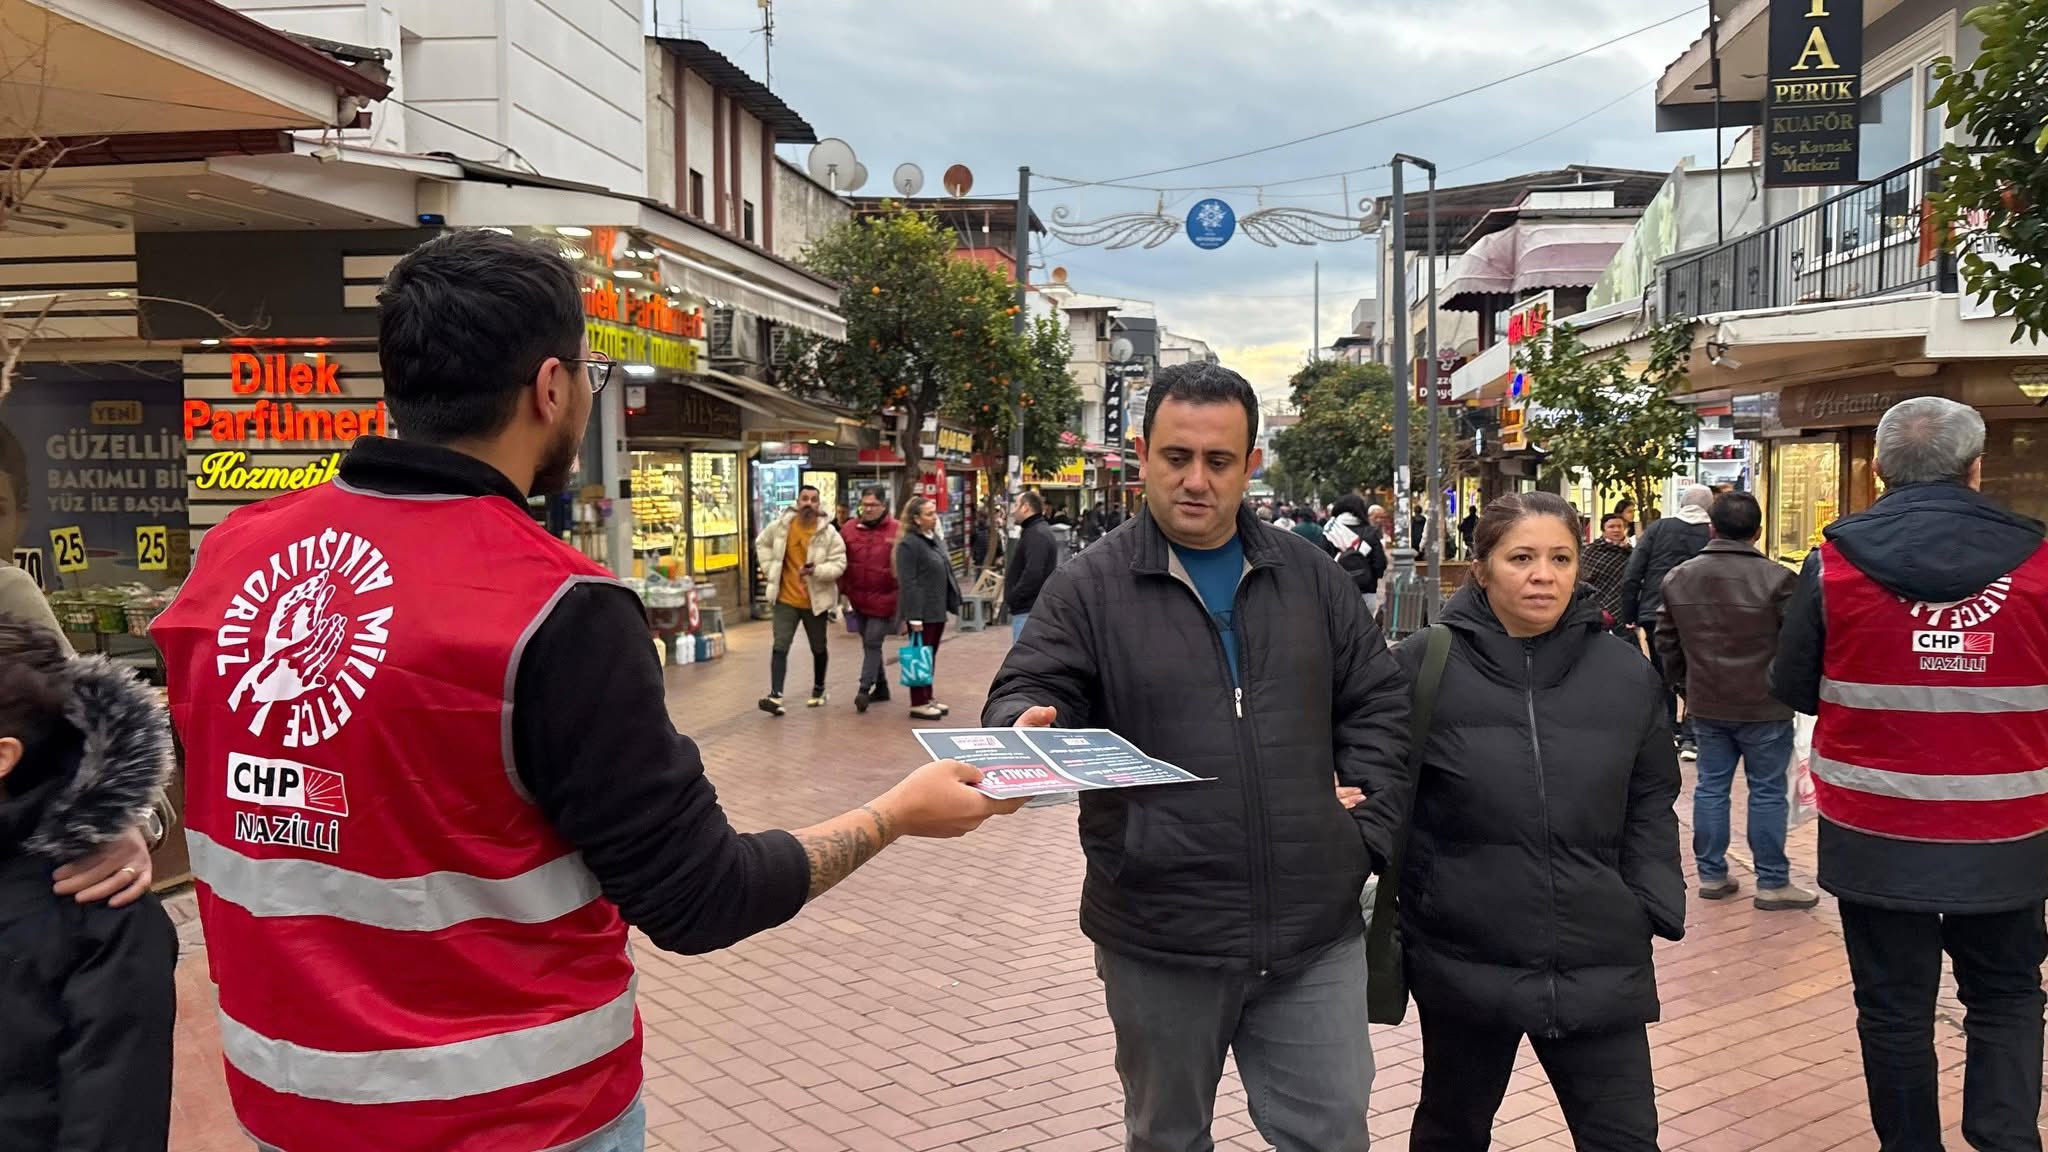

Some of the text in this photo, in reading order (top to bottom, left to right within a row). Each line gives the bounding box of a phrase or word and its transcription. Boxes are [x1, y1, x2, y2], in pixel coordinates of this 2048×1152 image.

[1774, 81, 1854, 103] PERUK
[1772, 111, 1854, 134] KUAFÖR
[1770, 139, 1853, 158] Saç Kaynak
[1782, 157, 1841, 173] Merkezi
[231, 352, 341, 395] Dilek
[95, 403, 137, 422] YENİ
[184, 399, 386, 441] Parfümeri
[48, 468, 146, 489] BAKIMLI
[196, 451, 341, 490] Kozmetik
[48, 494, 86, 513] YÜZ
[92, 492, 119, 512] İLE
[54, 532, 84, 566] 25
[139, 532, 165, 564] 25
[1918, 634, 1960, 649] CHP
[1919, 656, 1987, 672] NAZİLLİ
[282, 605, 394, 748] MİLLETÇE
[234, 762, 300, 797] CHP
[235, 811, 339, 854] NAZİLLİ
